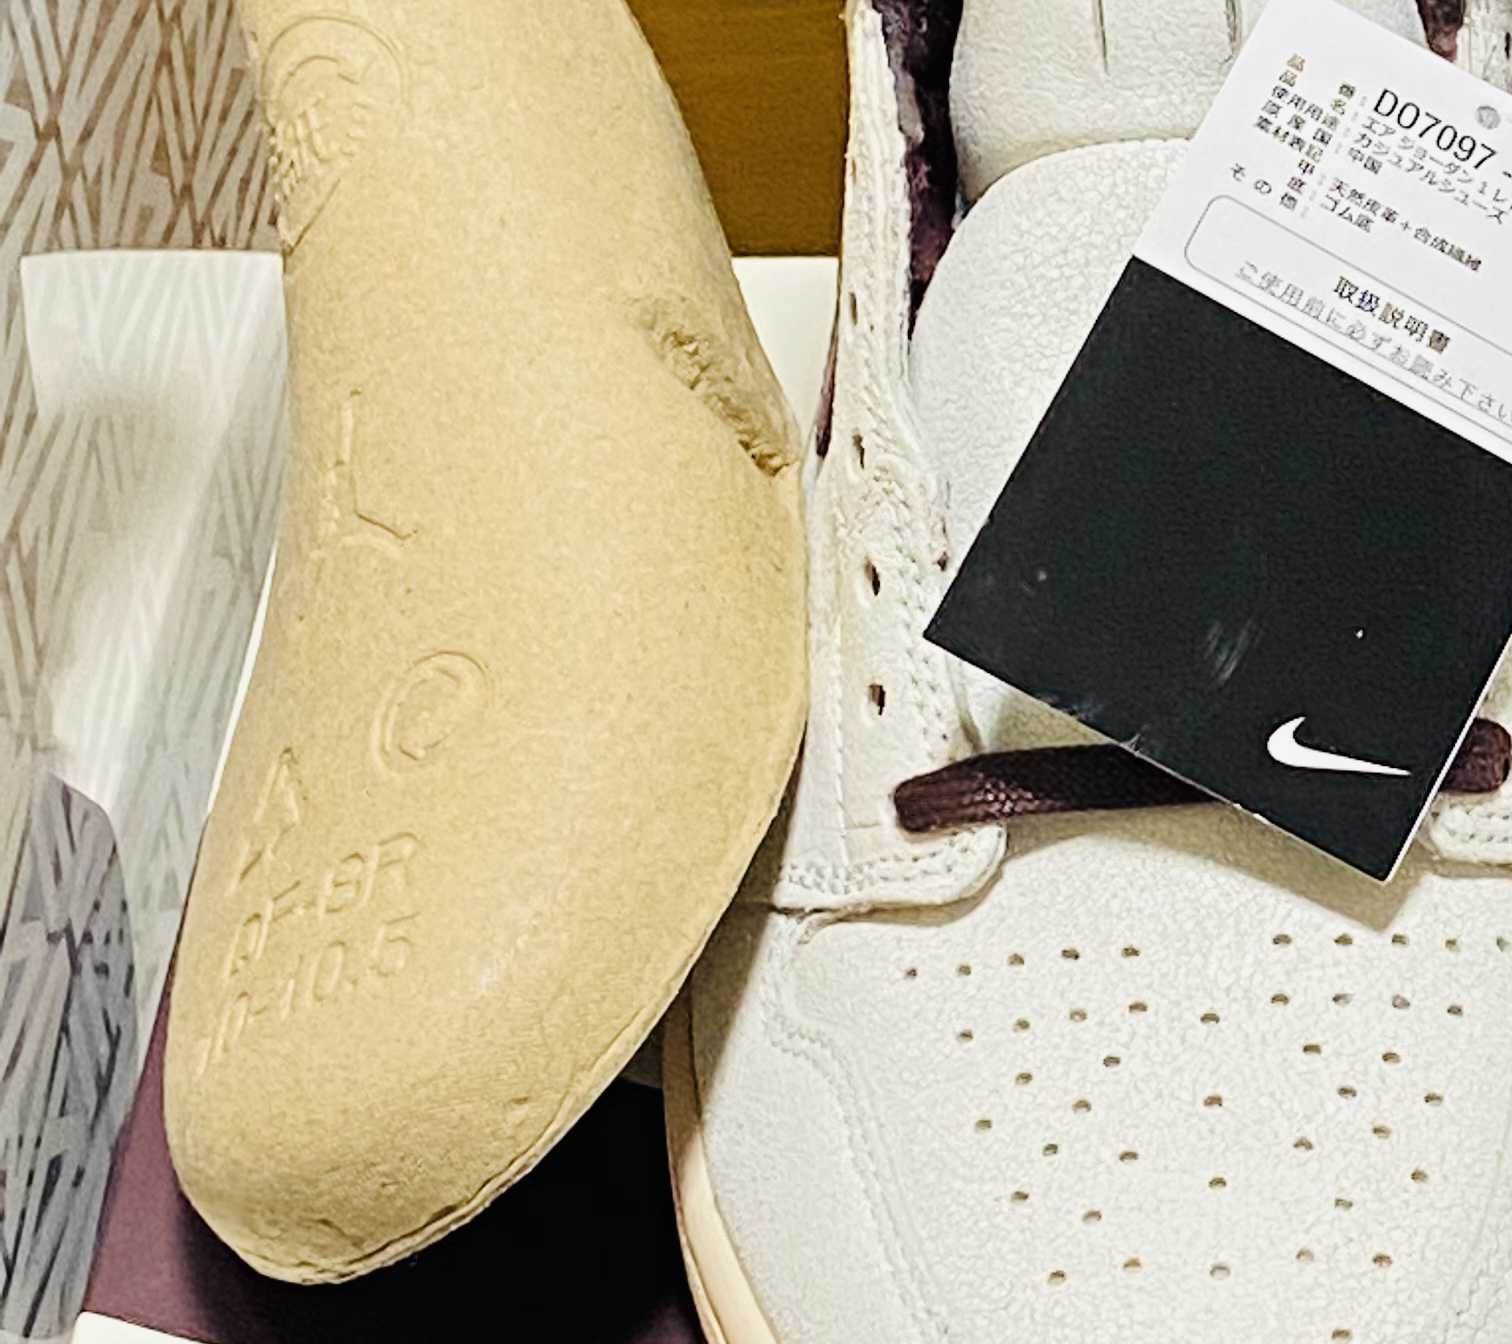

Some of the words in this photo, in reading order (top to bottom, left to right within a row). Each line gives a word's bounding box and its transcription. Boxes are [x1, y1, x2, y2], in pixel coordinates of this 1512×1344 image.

[1330, 276, 1452, 355] 取扱説明書
